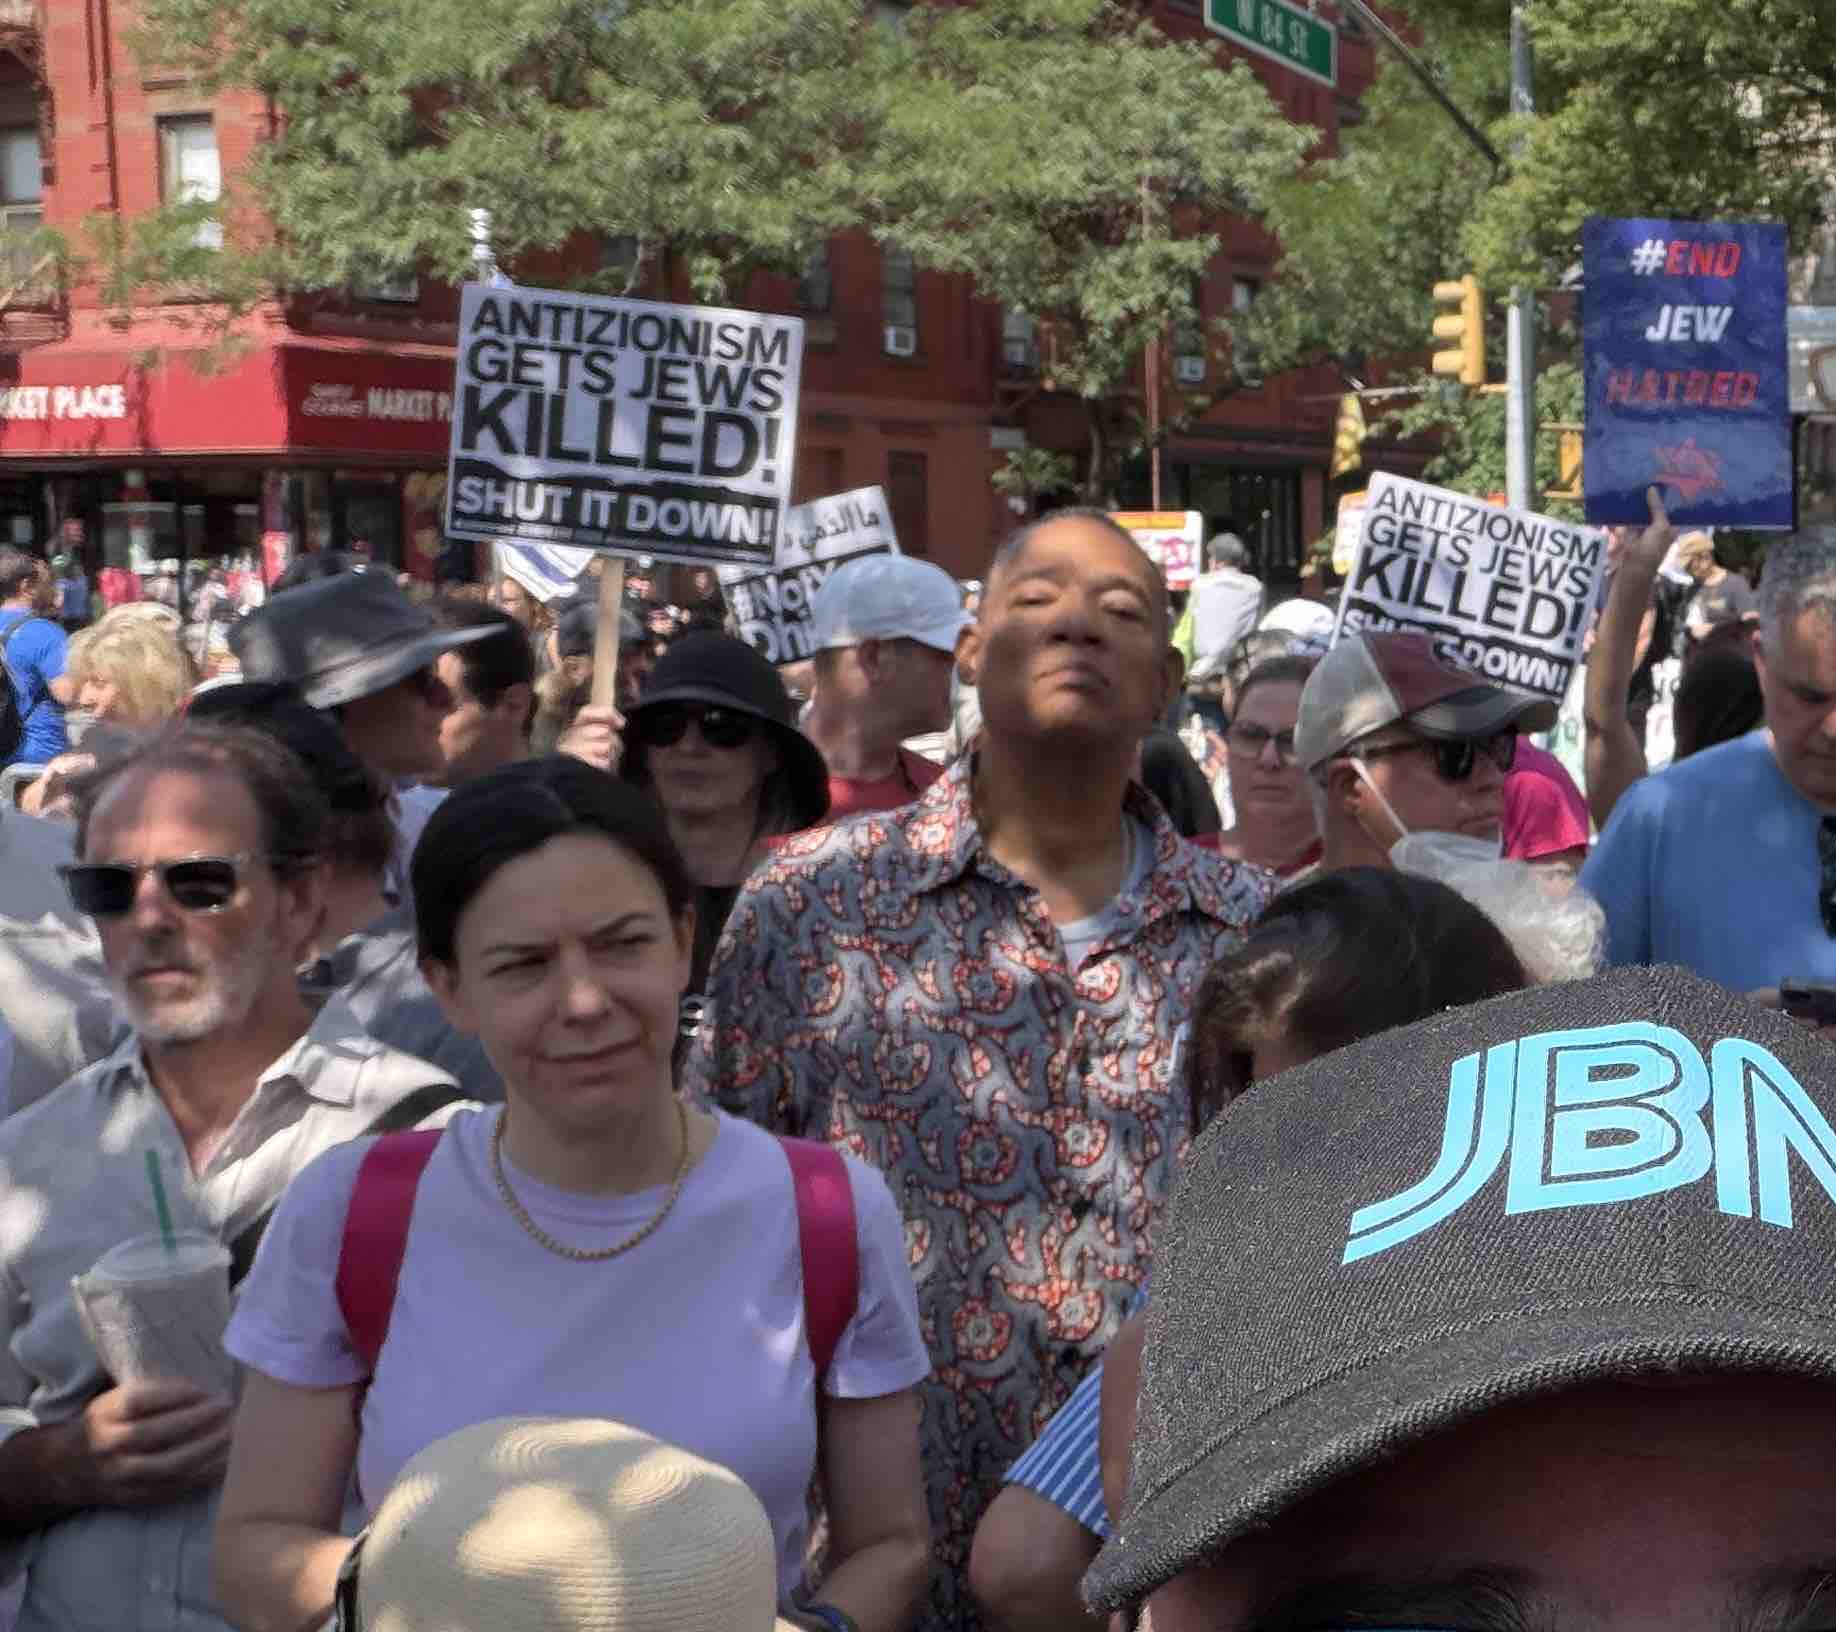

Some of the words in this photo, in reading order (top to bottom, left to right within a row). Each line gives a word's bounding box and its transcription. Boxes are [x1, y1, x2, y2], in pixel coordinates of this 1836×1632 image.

[1260, 4, 1284, 47] 84
[1630, 238, 1742, 278] #END
[470, 297, 790, 366] ANTIZIONISM
[1645, 304, 1734, 342] JEW
[53, 384, 126, 419] PLACE
[467, 338, 616, 396] GETS
[628, 355, 785, 413] JEWS
[1605, 369, 1760, 407] HATRED
[461, 384, 782, 484] KILLED!
[455, 475, 572, 522] SHUT
[580, 489, 618, 526] IT
[626, 494, 774, 545] DOWN!
[1375, 486, 1600, 567] ANTIZIONISM
[1368, 515, 1472, 567] GETS
[1480, 543, 1592, 599] JEWS
[1354, 545, 1585, 650] KILLED!
[1464, 639, 1568, 692] DOWN!
